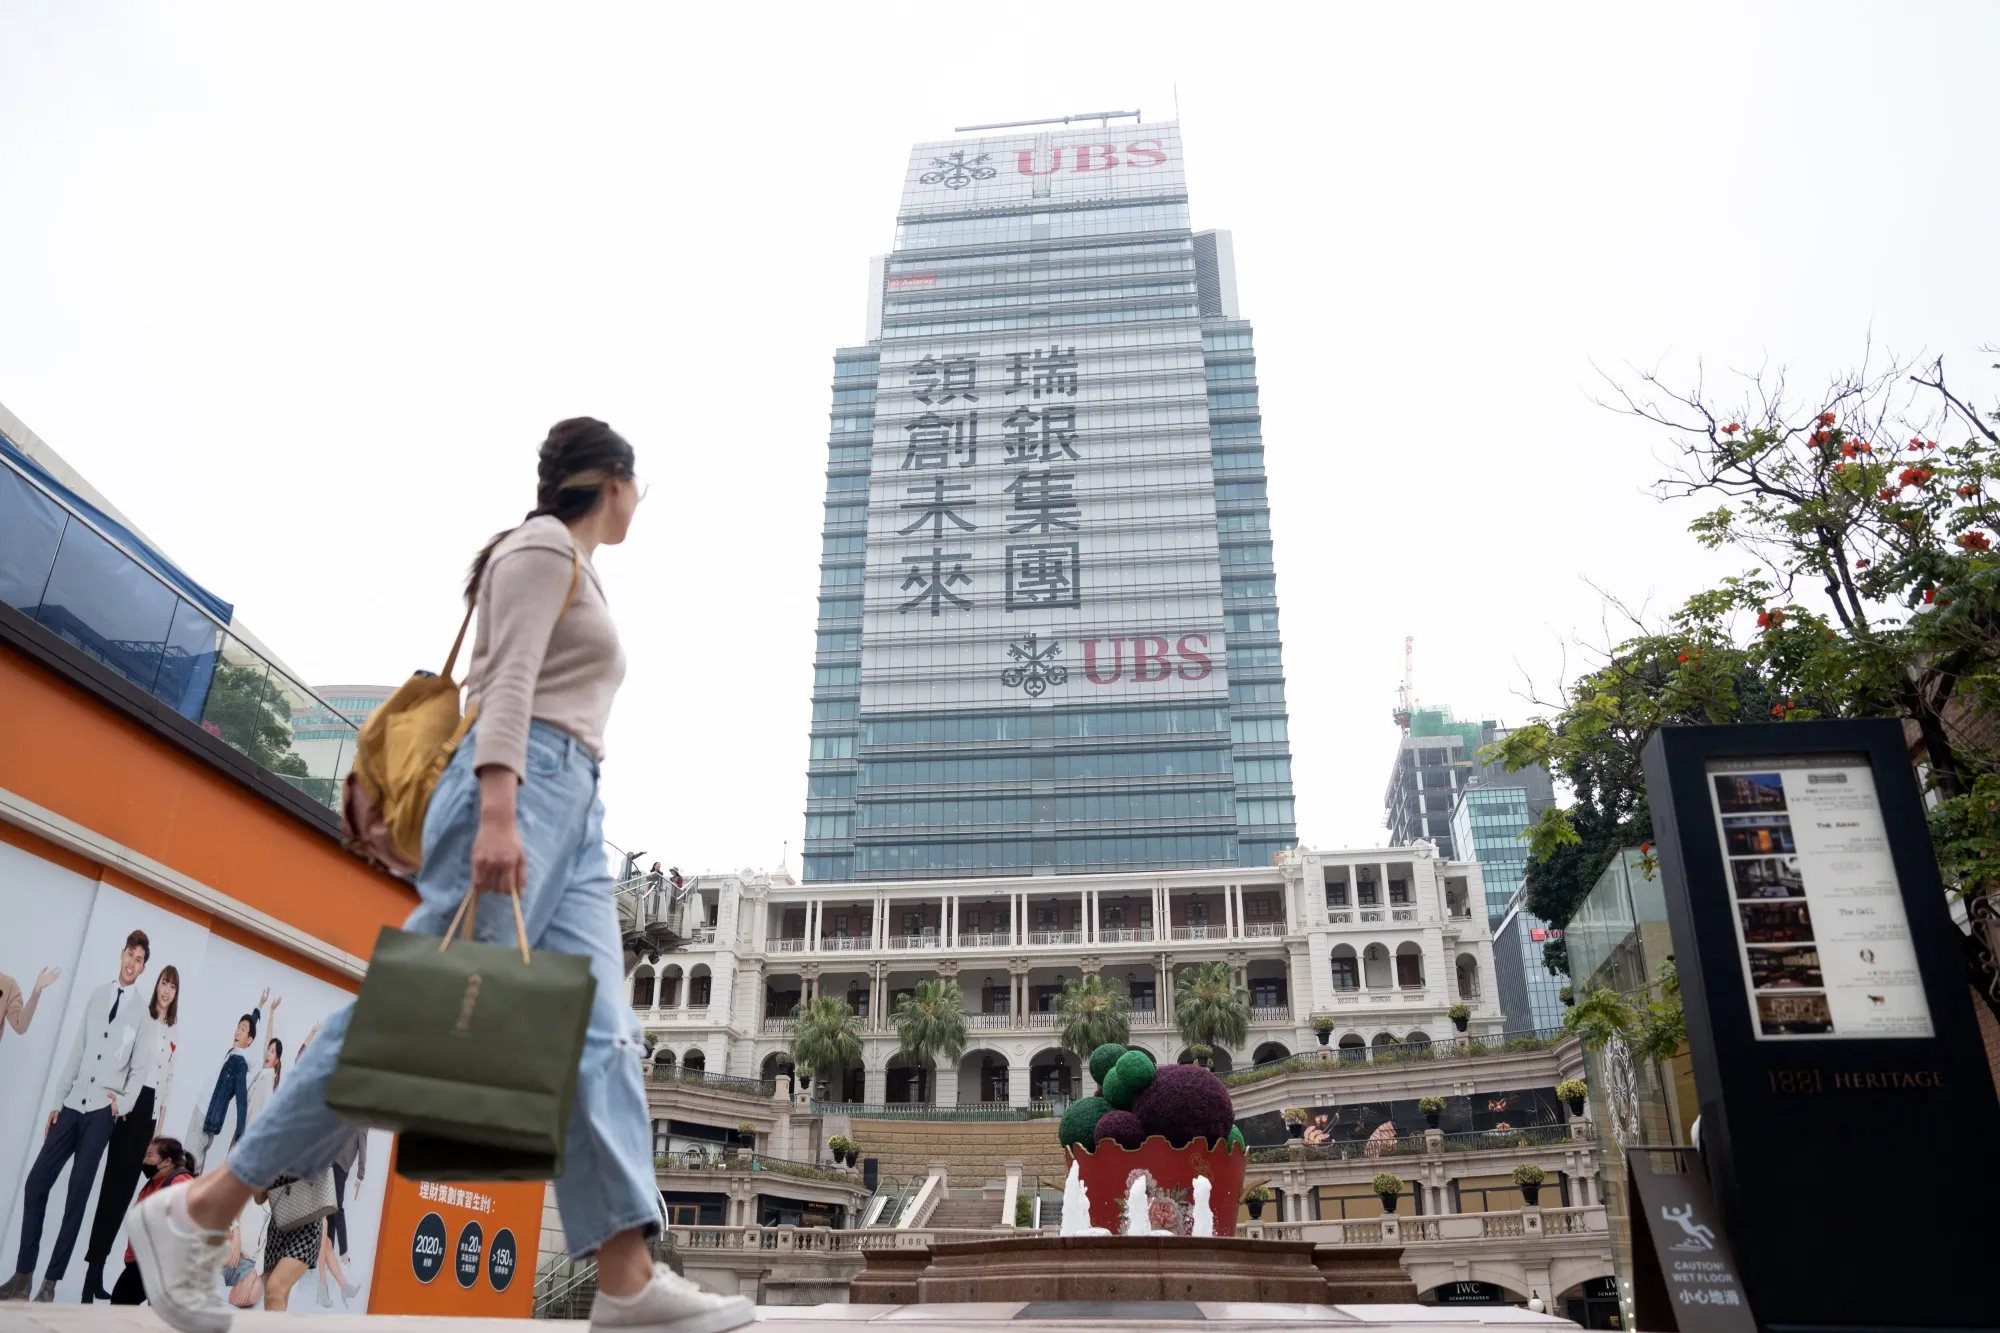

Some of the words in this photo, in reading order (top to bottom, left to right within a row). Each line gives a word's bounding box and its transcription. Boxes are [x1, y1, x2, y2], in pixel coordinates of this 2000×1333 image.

[1013, 139, 1168, 177] UBS
[896, 351, 980, 617] 領創未來
[1001, 344, 1082, 614] 瑞銀集團
[1079, 633, 1212, 684] UBS
[1768, 1069, 1823, 1093] 1881
[1834, 1071, 1944, 1089] HERITAGE
[1672, 1272, 1694, 1282] WET
[1697, 1273, 1733, 1283] FLOOR
[1674, 1261, 1725, 1270] CAUTION!
[1456, 1283, 1480, 1294] IWC
